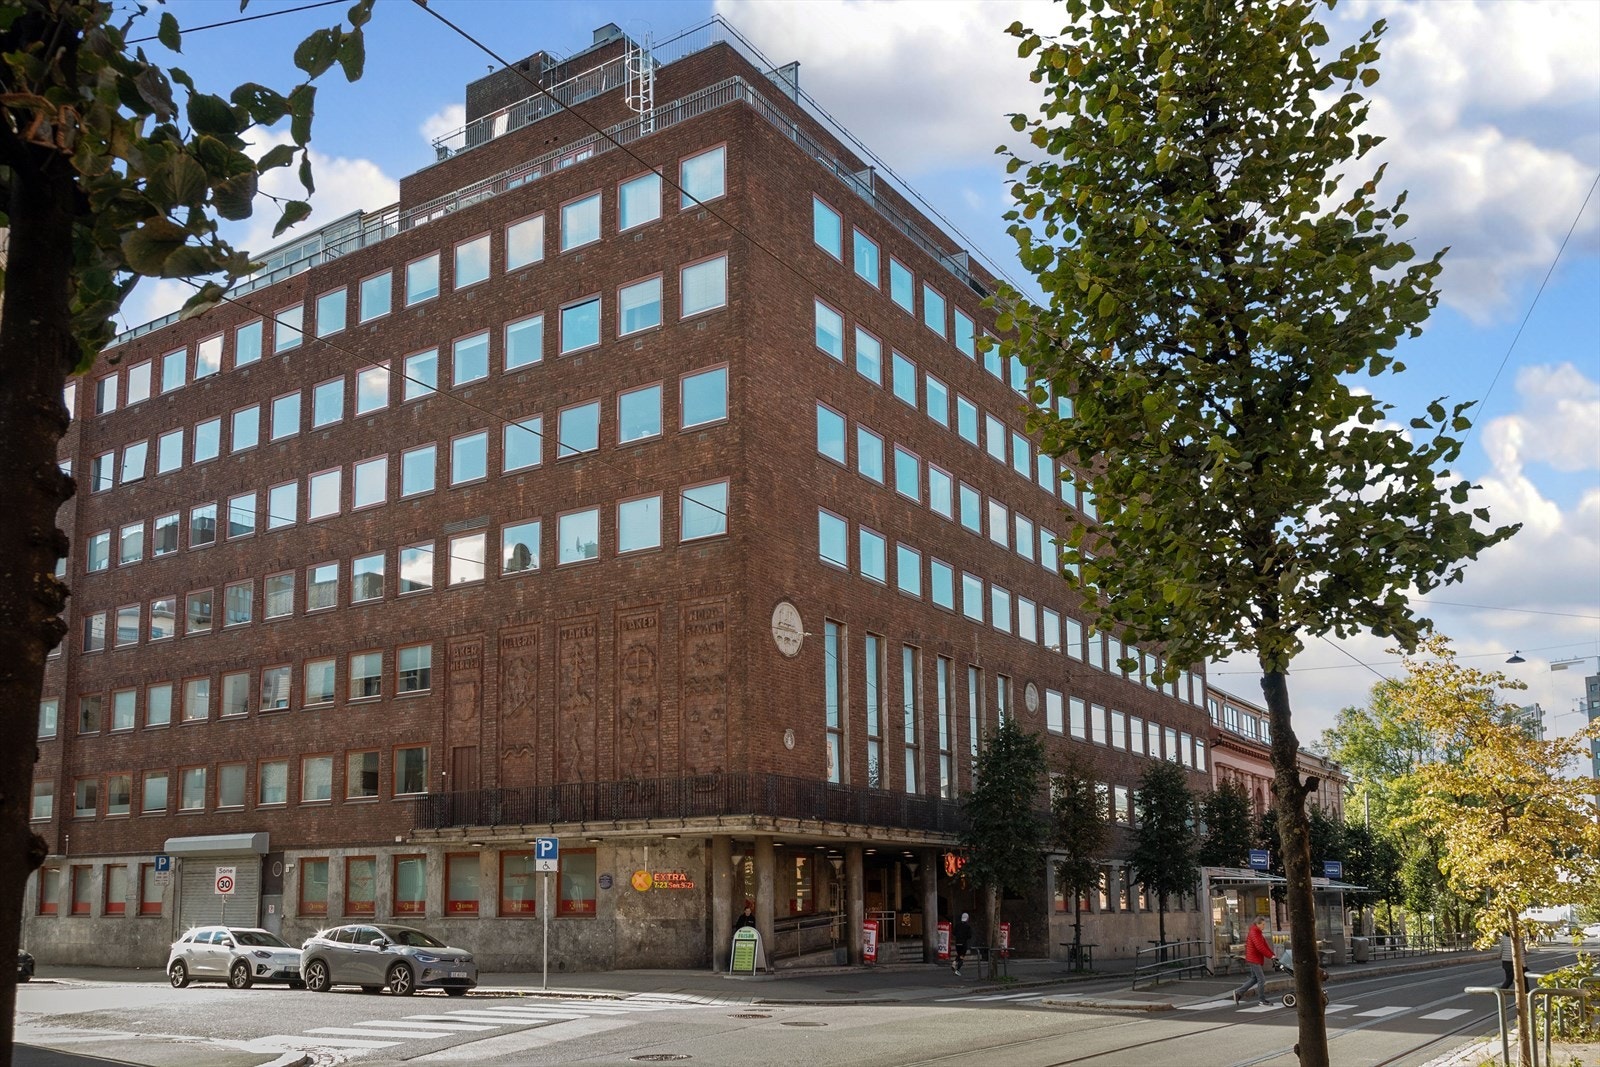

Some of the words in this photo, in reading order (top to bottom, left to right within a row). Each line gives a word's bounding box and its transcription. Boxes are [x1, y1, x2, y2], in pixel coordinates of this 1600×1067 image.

[541, 840, 553, 857] P
[158, 857, 167, 870] P
[654, 873, 687, 881] EXTRA
[220, 880, 231, 889] 30
